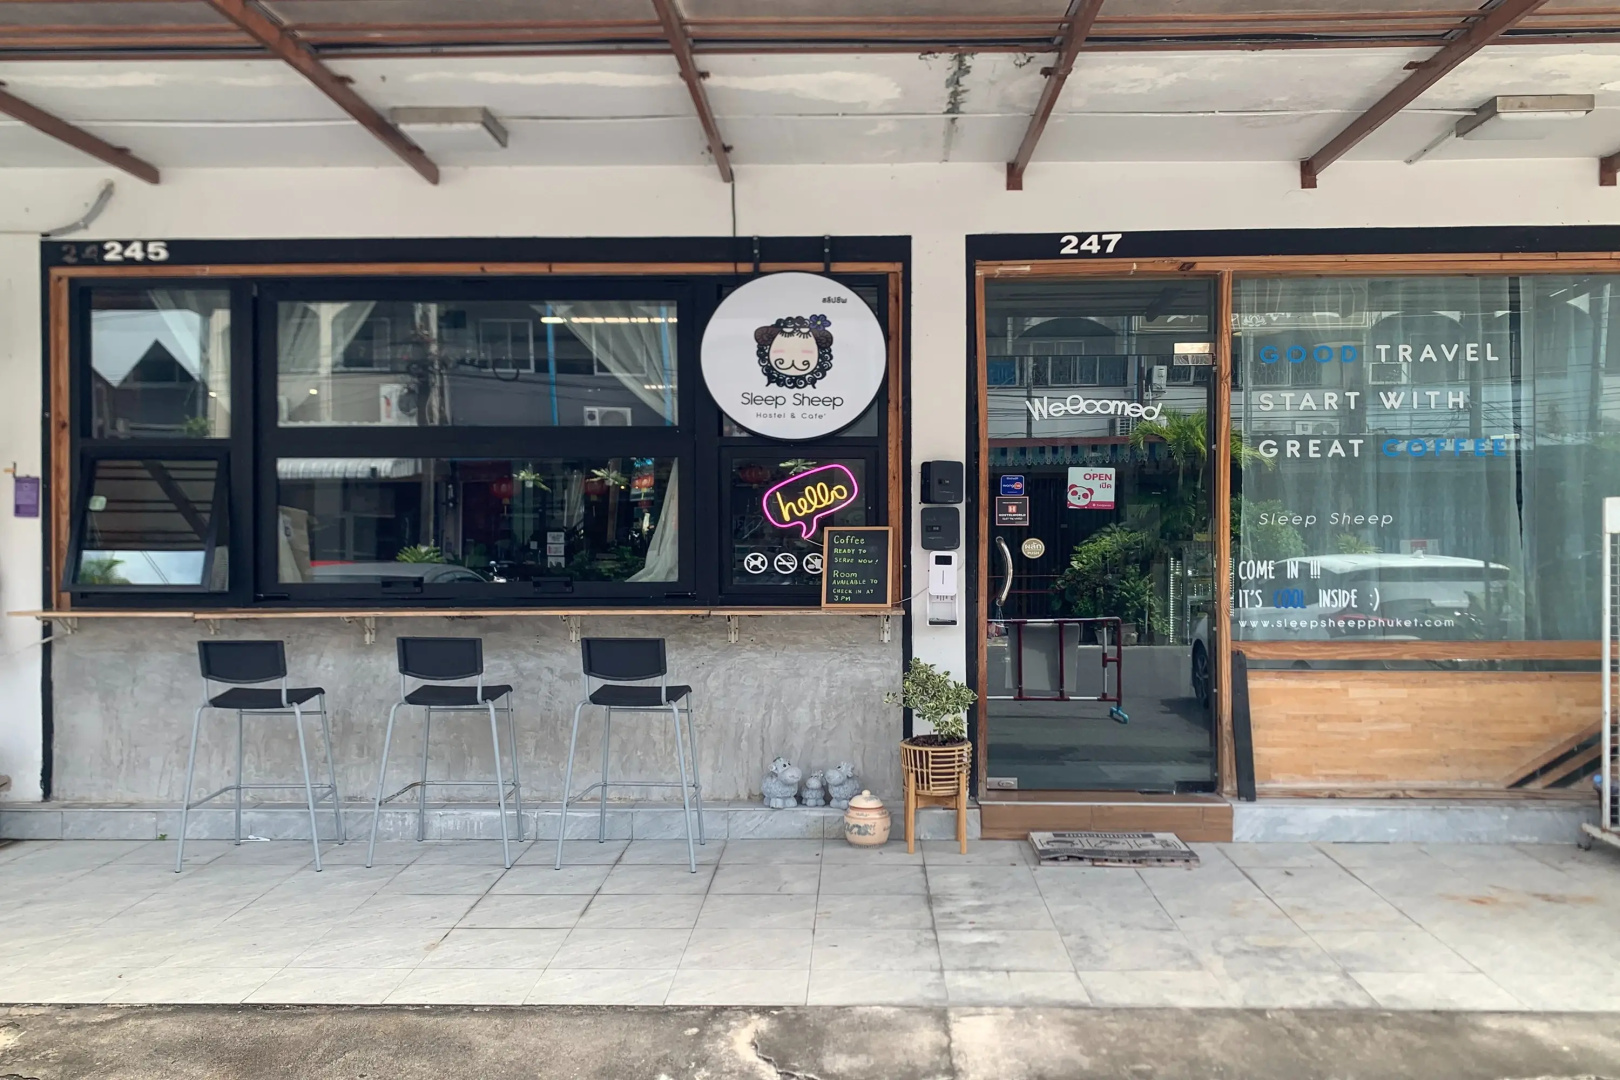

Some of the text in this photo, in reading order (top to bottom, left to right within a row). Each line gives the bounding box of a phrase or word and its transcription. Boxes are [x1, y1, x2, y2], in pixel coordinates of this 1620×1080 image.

[103, 240, 169, 262] 245
[1060, 233, 1122, 254] 247
[1259, 343, 1499, 364] GOOD TRAVEL
[741, 392, 844, 410] Sleep Sheep
[1259, 391, 1464, 411] START WITH
[1258, 438, 1507, 458] GREAT COFFEE
[1084, 473, 1112, 481] OPEN
[776, 481, 848, 522] hello
[1258, 512, 1393, 528] Sleep Sheep
[834, 535, 865, 544] Coffee
[1025, 542, 1042, 550] ผลัก
[833, 570, 857, 578] Room
[1239, 560, 1275, 580] COME
[1287, 560, 1298, 579] IN
[1239, 589, 1262, 608] IT'S
[1273, 588, 1307, 609] COOL
[1319, 589, 1358, 608] INSIDE
[1238, 618, 1454, 630] www.sleepsheepphuket.com
